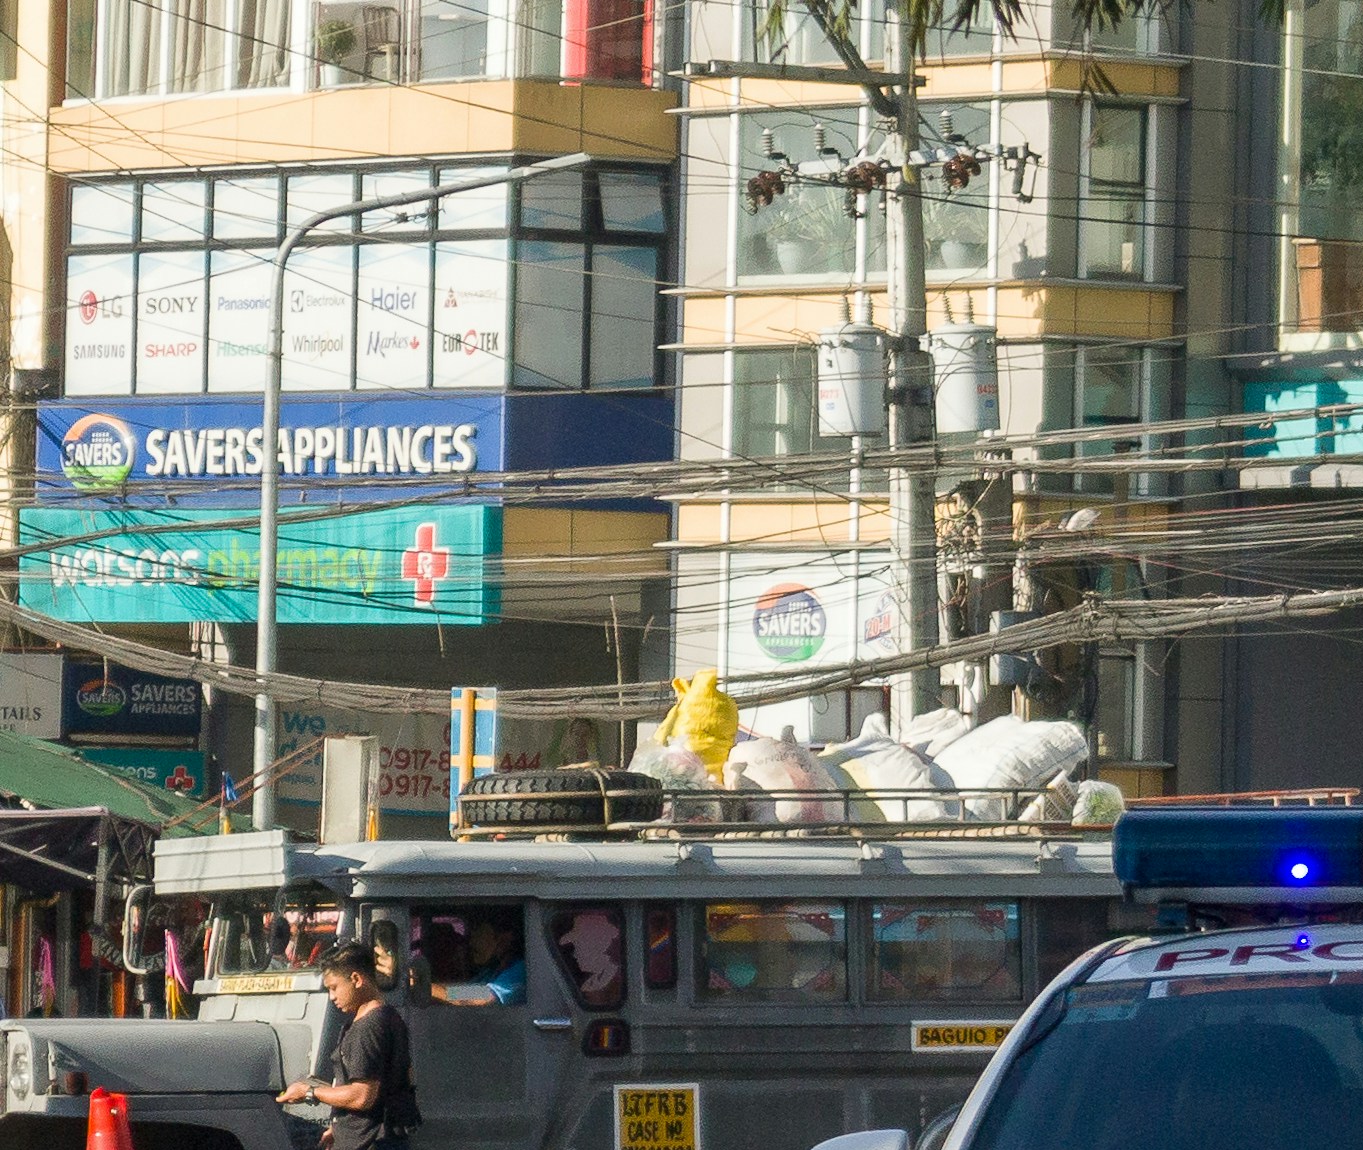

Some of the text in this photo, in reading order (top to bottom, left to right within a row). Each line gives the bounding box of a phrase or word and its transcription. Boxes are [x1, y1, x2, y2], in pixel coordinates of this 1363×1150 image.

[102, 295, 123, 319] LG
[145, 296, 198, 314] SONY
[218, 296, 271, 311] Panasonic
[371, 286, 417, 310] Haier
[74, 344, 125, 360] SAMSUNG
[145, 342, 197, 358] SHARP
[292, 334, 343, 357] Whirlpool
[64, 442, 122, 467] SAVERS
[145, 423, 478, 476] SAVERS APPLIANCES
[51, 547, 200, 587] watsons
[758, 612, 822, 637] SAVERS
[131, 684, 196, 702] SAVERS
[130, 703, 196, 714] APPLIANCES
[282, 711, 327, 735] We
[920, 1027, 987, 1045] BAGUIO
[622, 1093, 688, 1117] LTFRB
[627, 1120, 661, 1143] CASE
